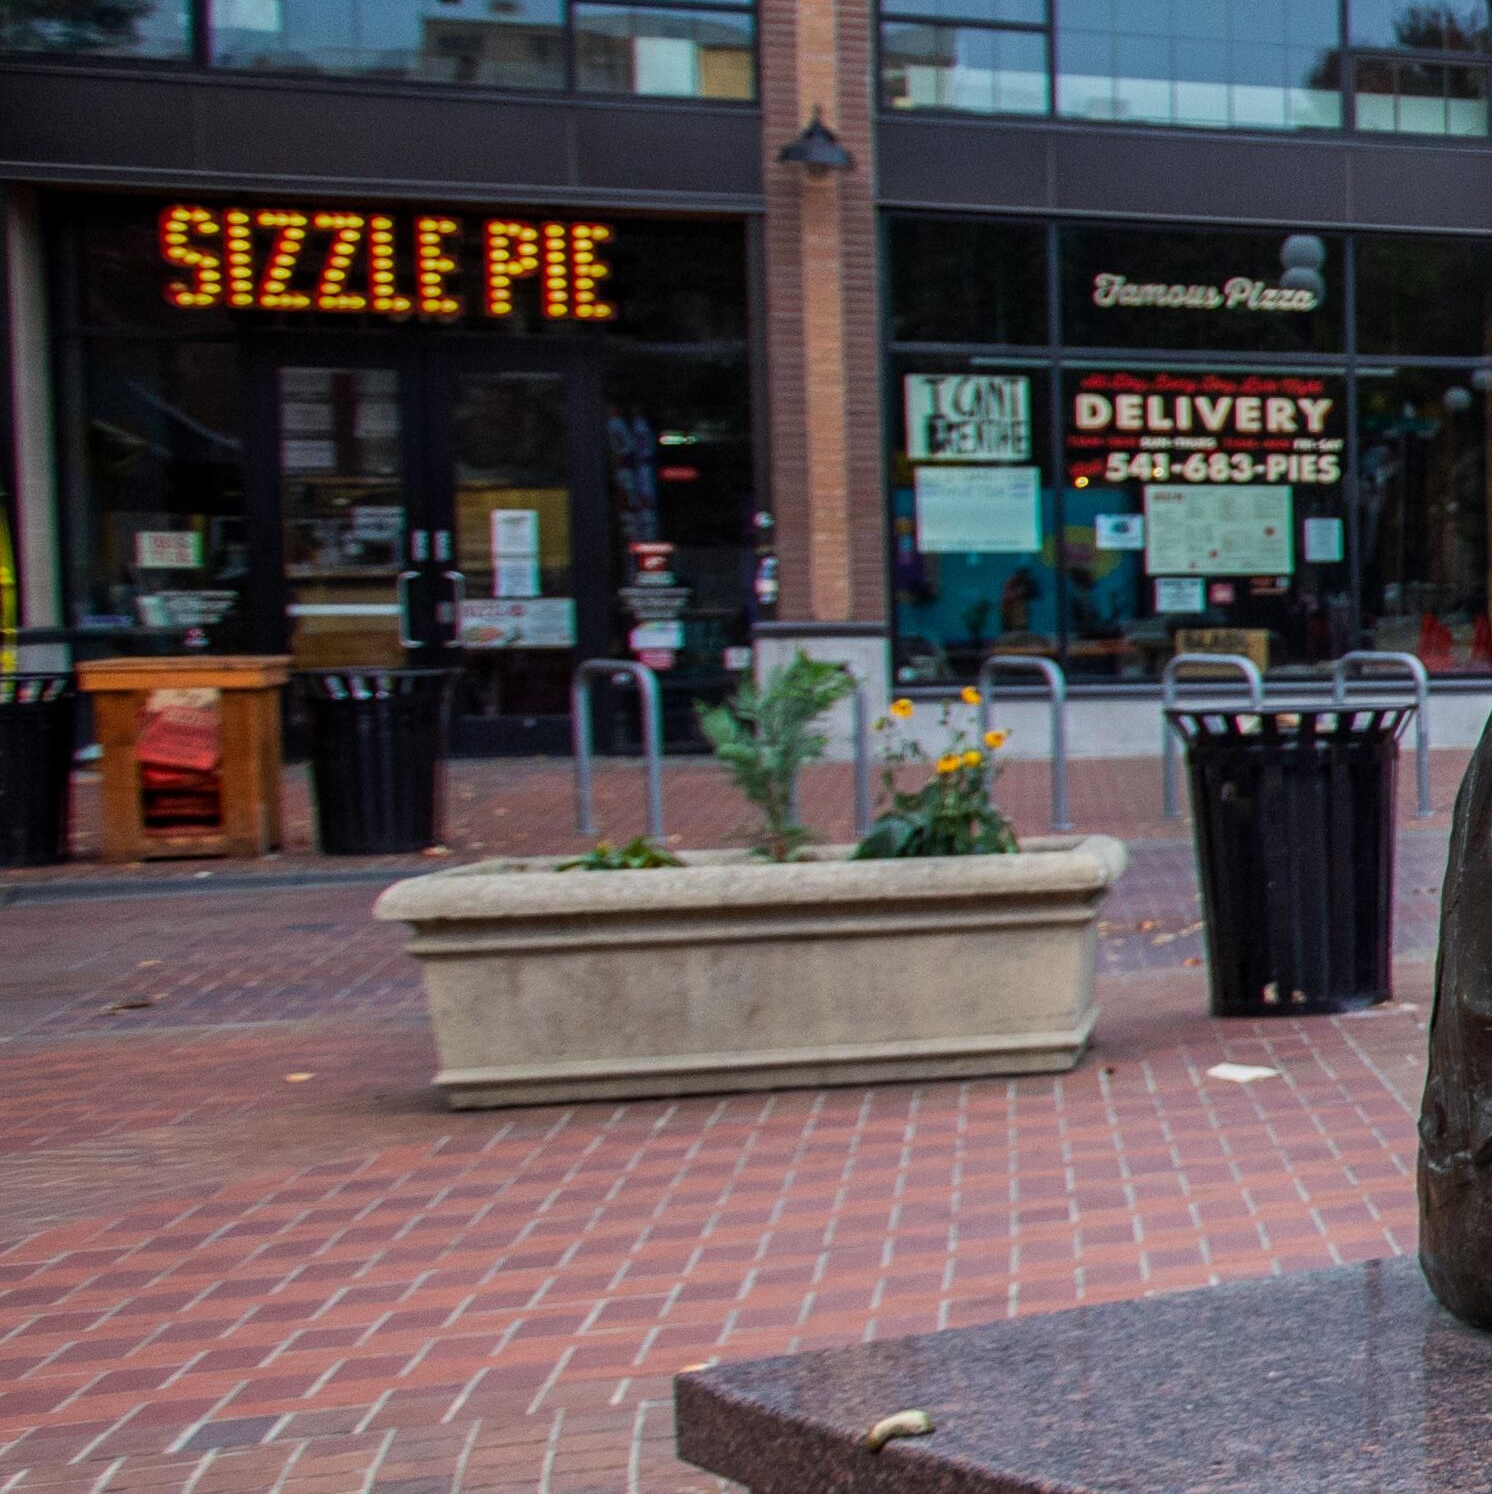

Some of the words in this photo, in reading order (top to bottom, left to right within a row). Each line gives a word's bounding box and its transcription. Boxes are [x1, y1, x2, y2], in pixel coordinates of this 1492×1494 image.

[162, 206, 460, 314] SIZZLE
[485, 216, 619, 319] PIE
[1093, 272, 1223, 308] Famous
[1224, 276, 1319, 311] Pizza
[1074, 392, 1333, 433] DELIVERY
[1105, 452, 1342, 484] 541-683-PIES
